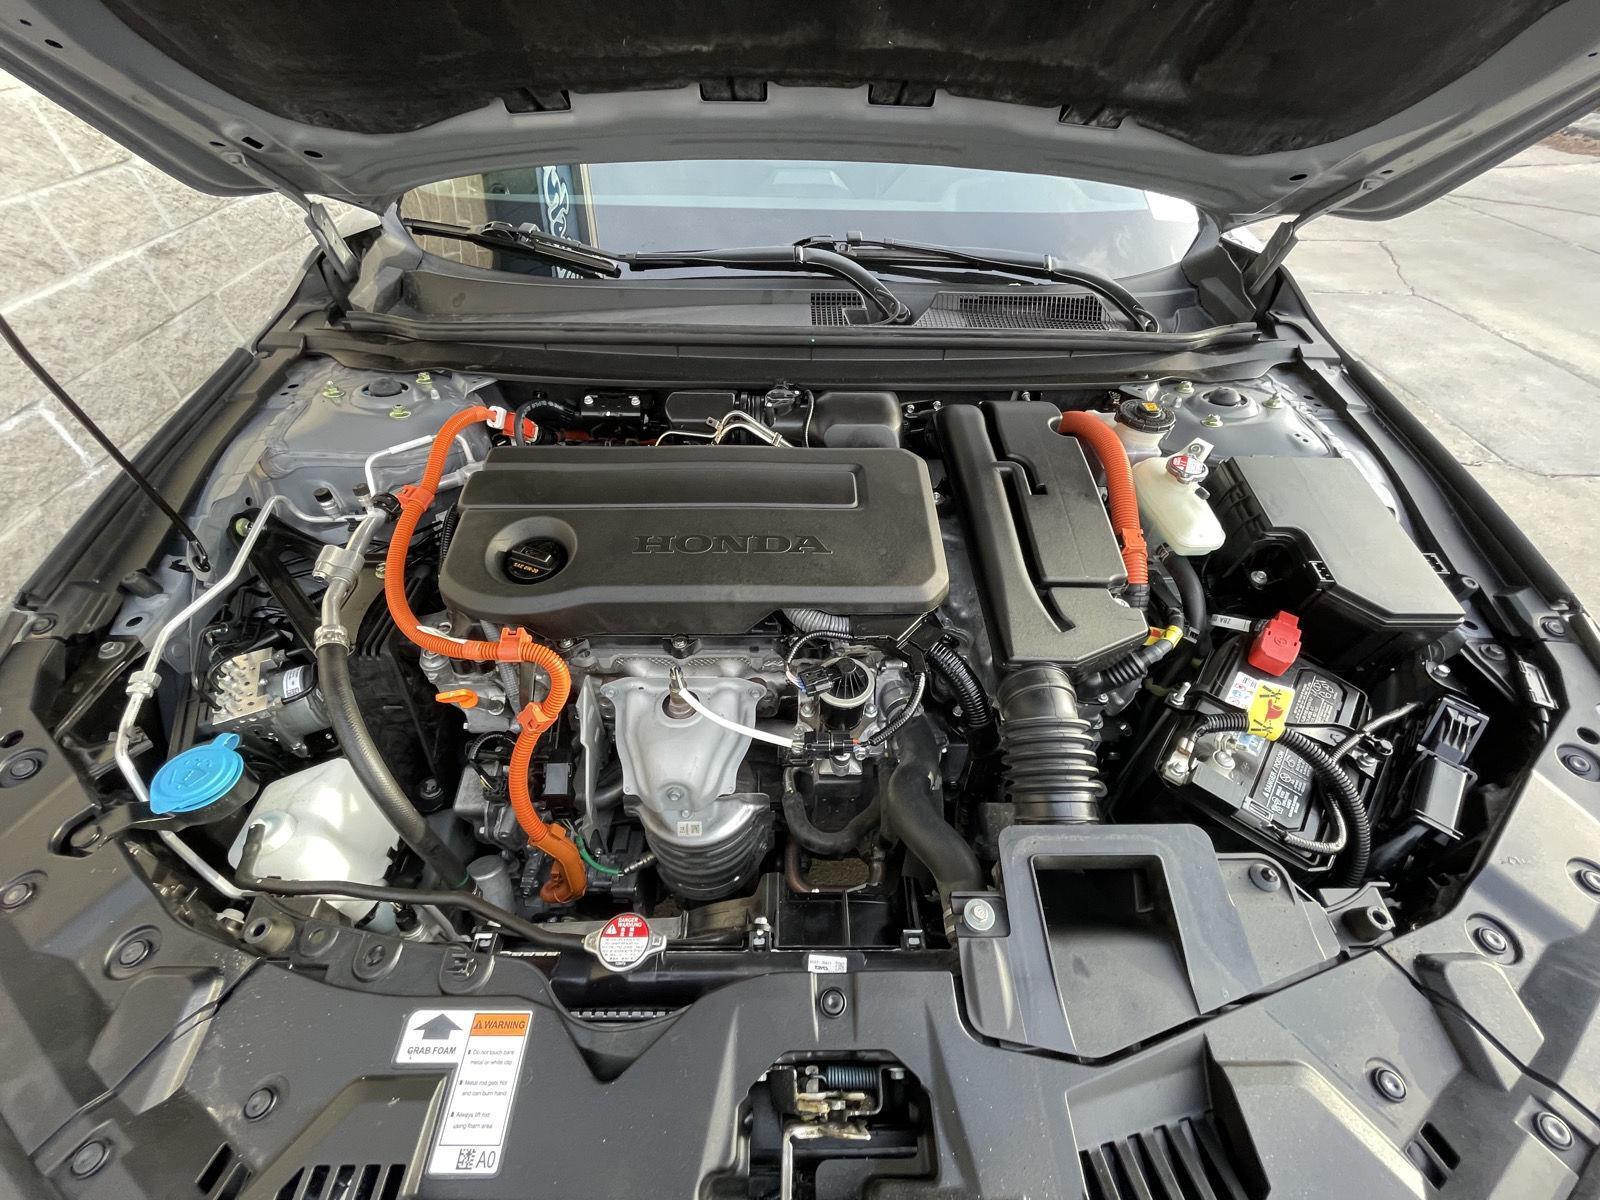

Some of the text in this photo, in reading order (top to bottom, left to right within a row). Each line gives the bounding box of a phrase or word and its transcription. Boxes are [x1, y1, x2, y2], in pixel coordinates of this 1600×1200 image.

[631, 535, 834, 555] HONDA
[1264, 769, 1277, 793] DANGER
[1273, 750, 1284, 768] POISON
[484, 1021, 526, 1030] WARNING
[407, 1046, 457, 1055] GRAB FOAM
[455, 1111, 473, 1119] Always
